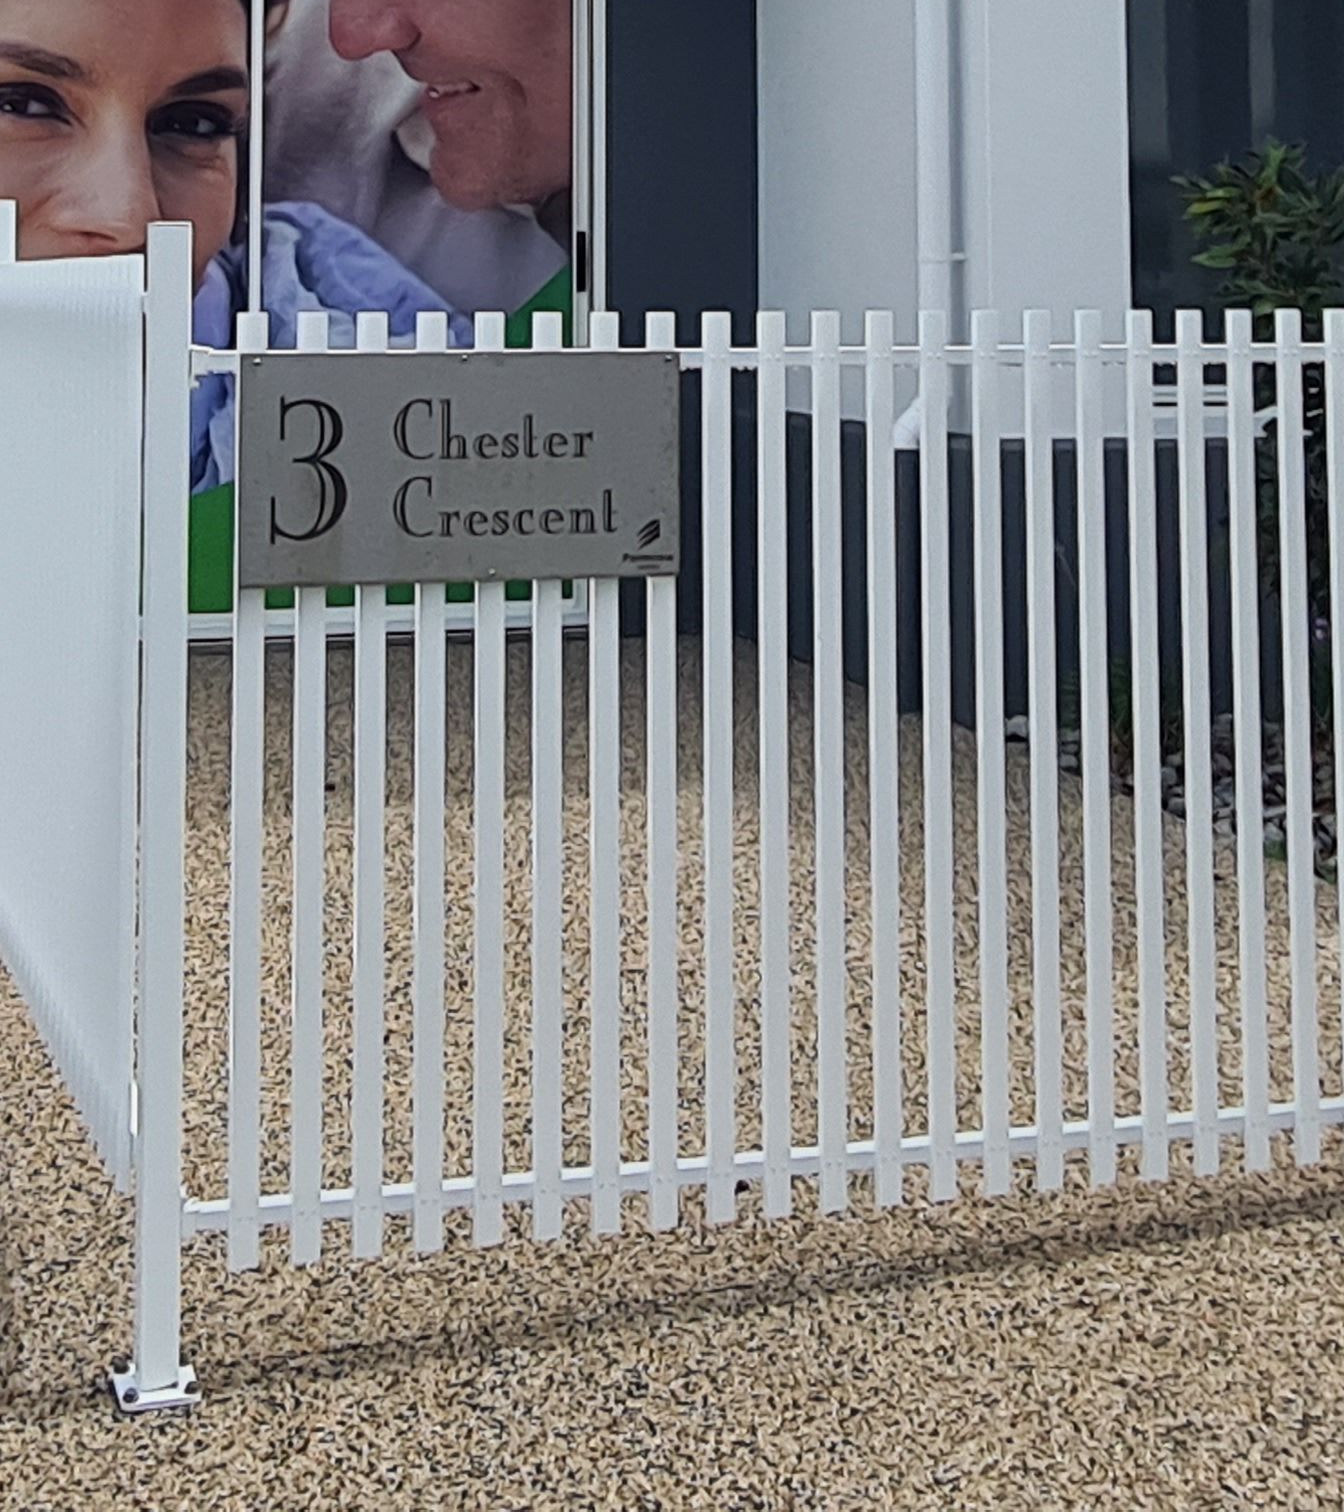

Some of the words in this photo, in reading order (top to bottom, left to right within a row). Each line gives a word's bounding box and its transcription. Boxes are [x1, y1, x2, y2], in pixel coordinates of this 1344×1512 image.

[393, 398, 594, 461] Chester
[269, 395, 348, 546] 3
[392, 475, 618, 538] Crescent
